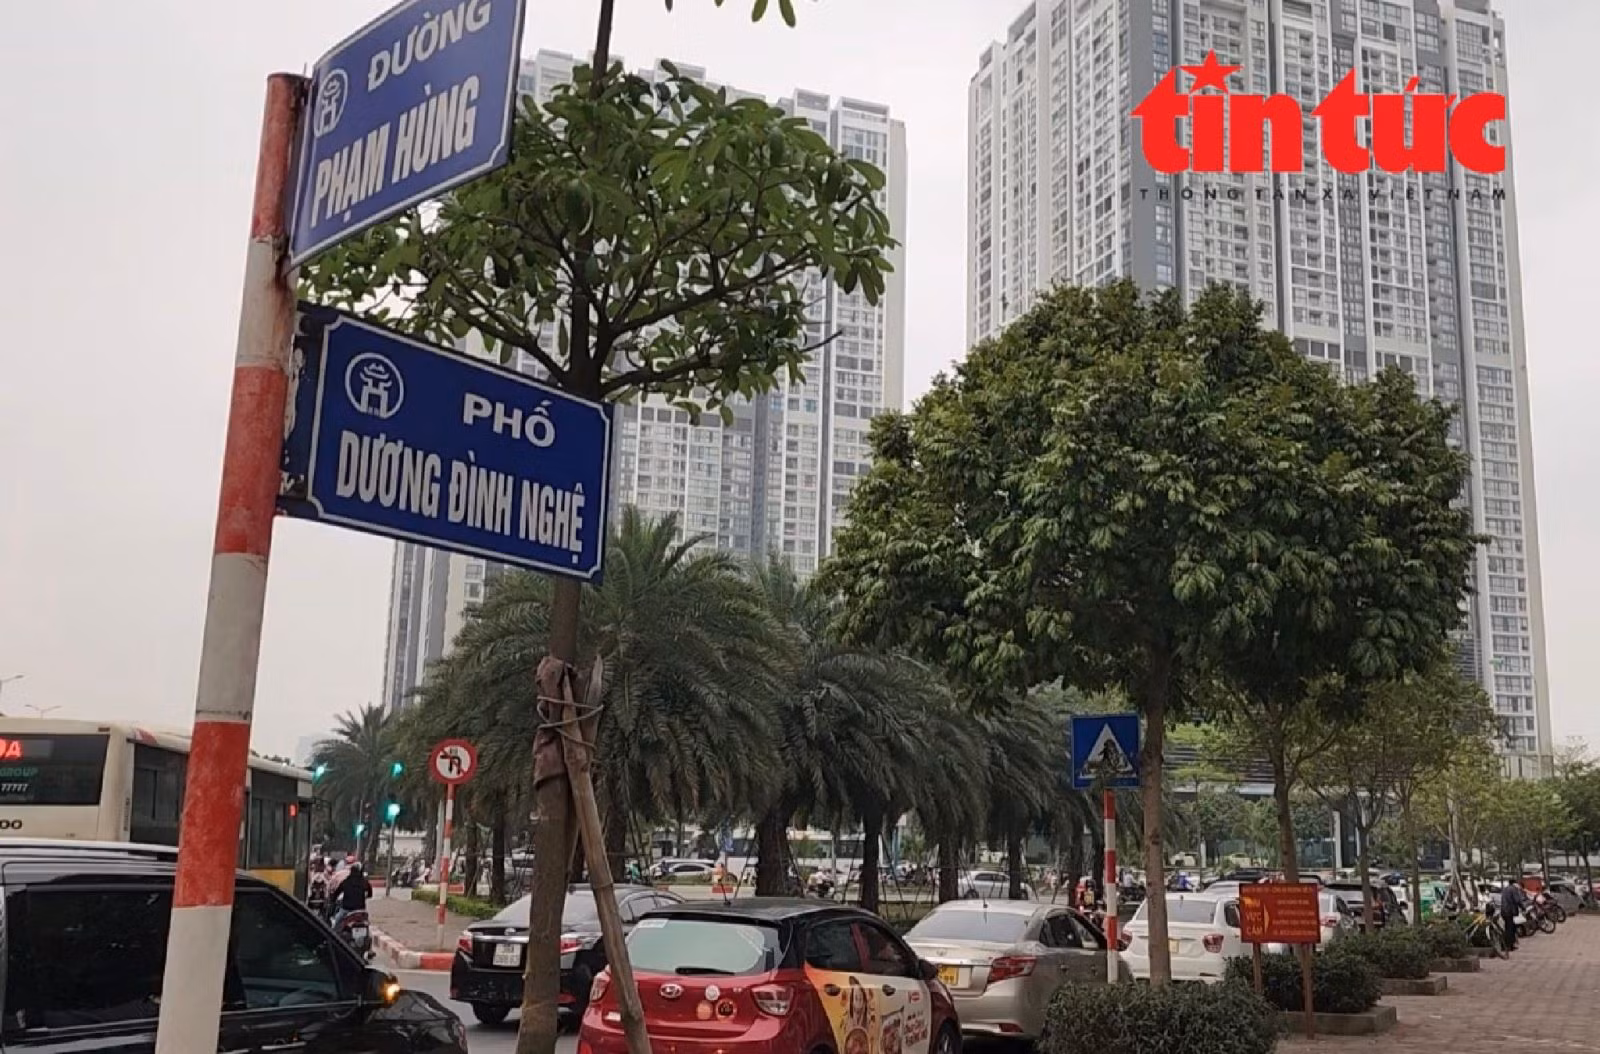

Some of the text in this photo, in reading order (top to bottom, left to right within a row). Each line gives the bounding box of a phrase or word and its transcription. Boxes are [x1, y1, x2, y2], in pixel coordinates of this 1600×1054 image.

[368, 0, 491, 92] ĐƯỜNG
[311, 75, 480, 228] PHẠM HÙNG
[463, 392, 556, 448] PHỐ
[336, 430, 585, 564] DƯƠNG ĐÌNH NGHỆ
